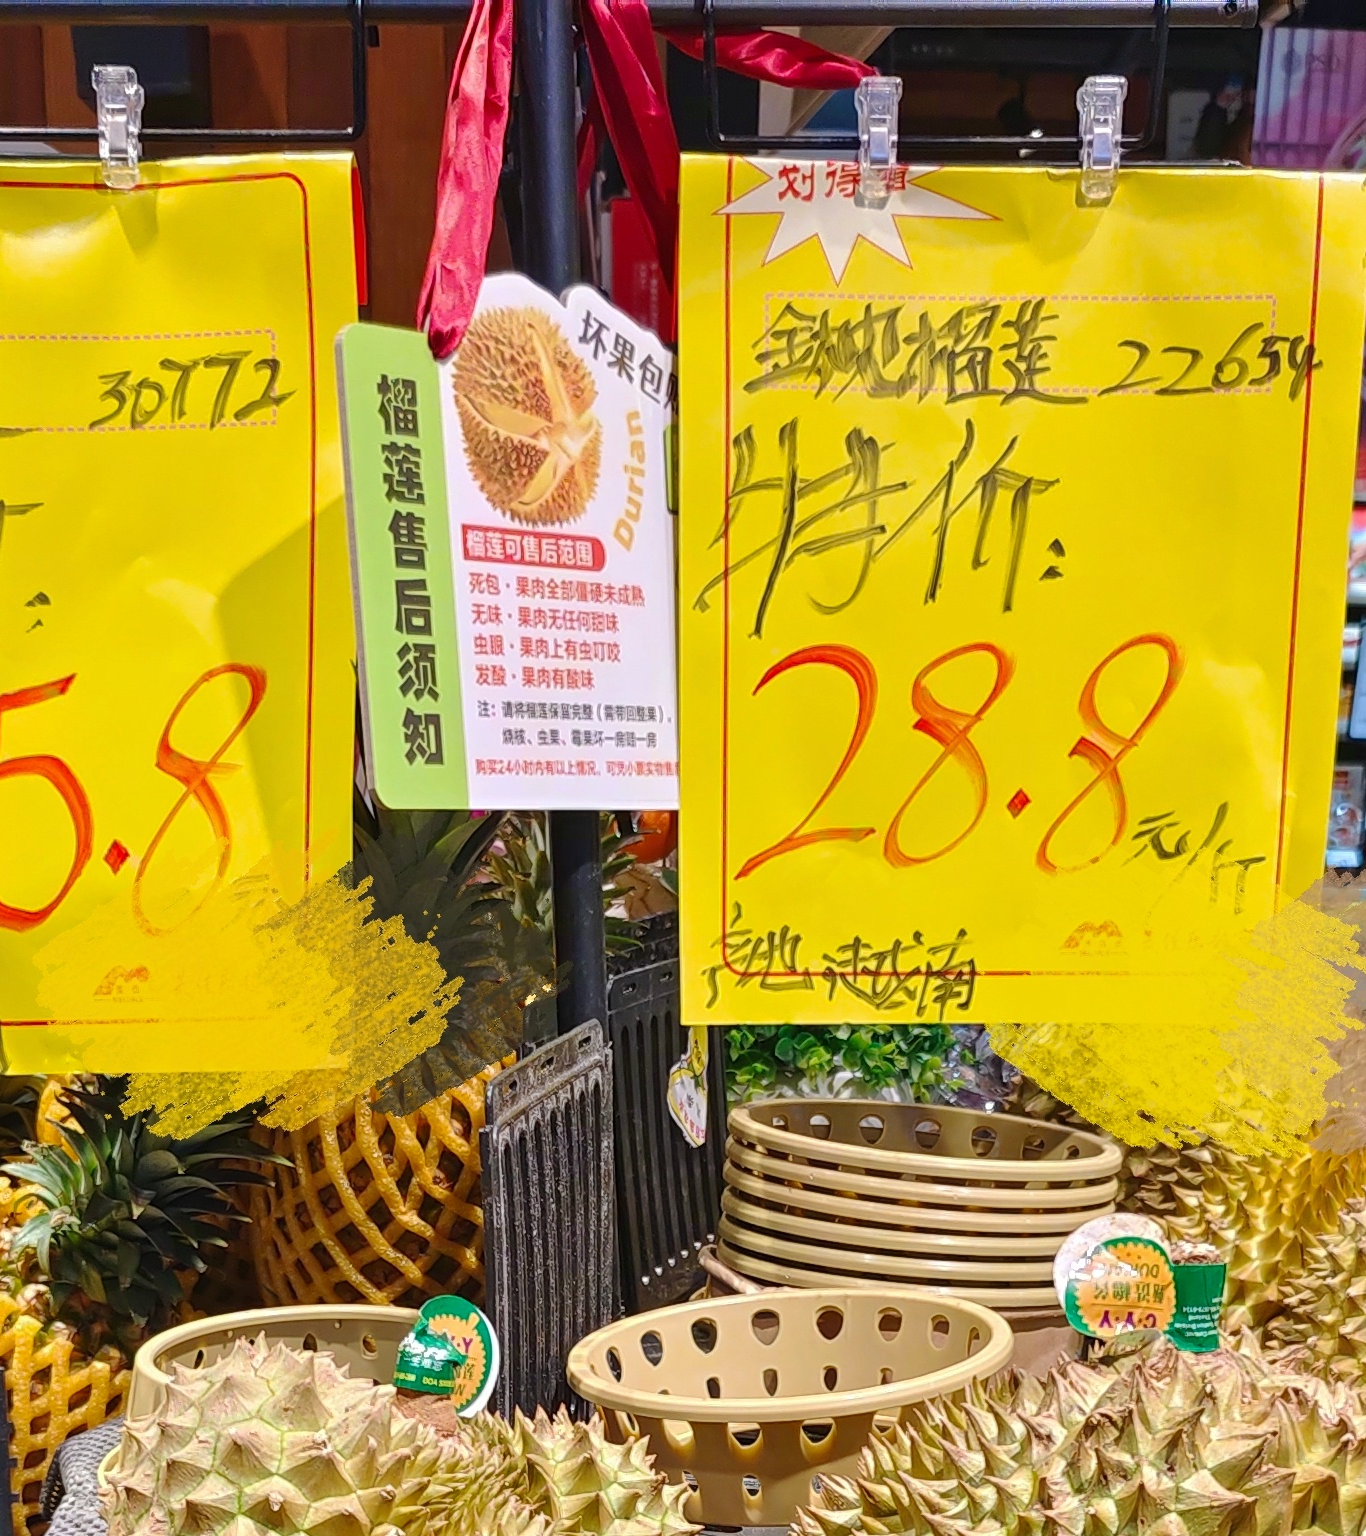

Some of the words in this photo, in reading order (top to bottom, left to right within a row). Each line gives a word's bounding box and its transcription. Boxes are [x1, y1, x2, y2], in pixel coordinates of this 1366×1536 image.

[89, 350, 297, 431] 30772
[1099, 322, 1323, 402] 22654
[613, 410, 646, 551] Durian
[377, 374, 445, 766] 榴莲售后须知
[465, 529, 594, 567] 榴莲可售后范围
[733, 633, 1188, 881] 28.8
